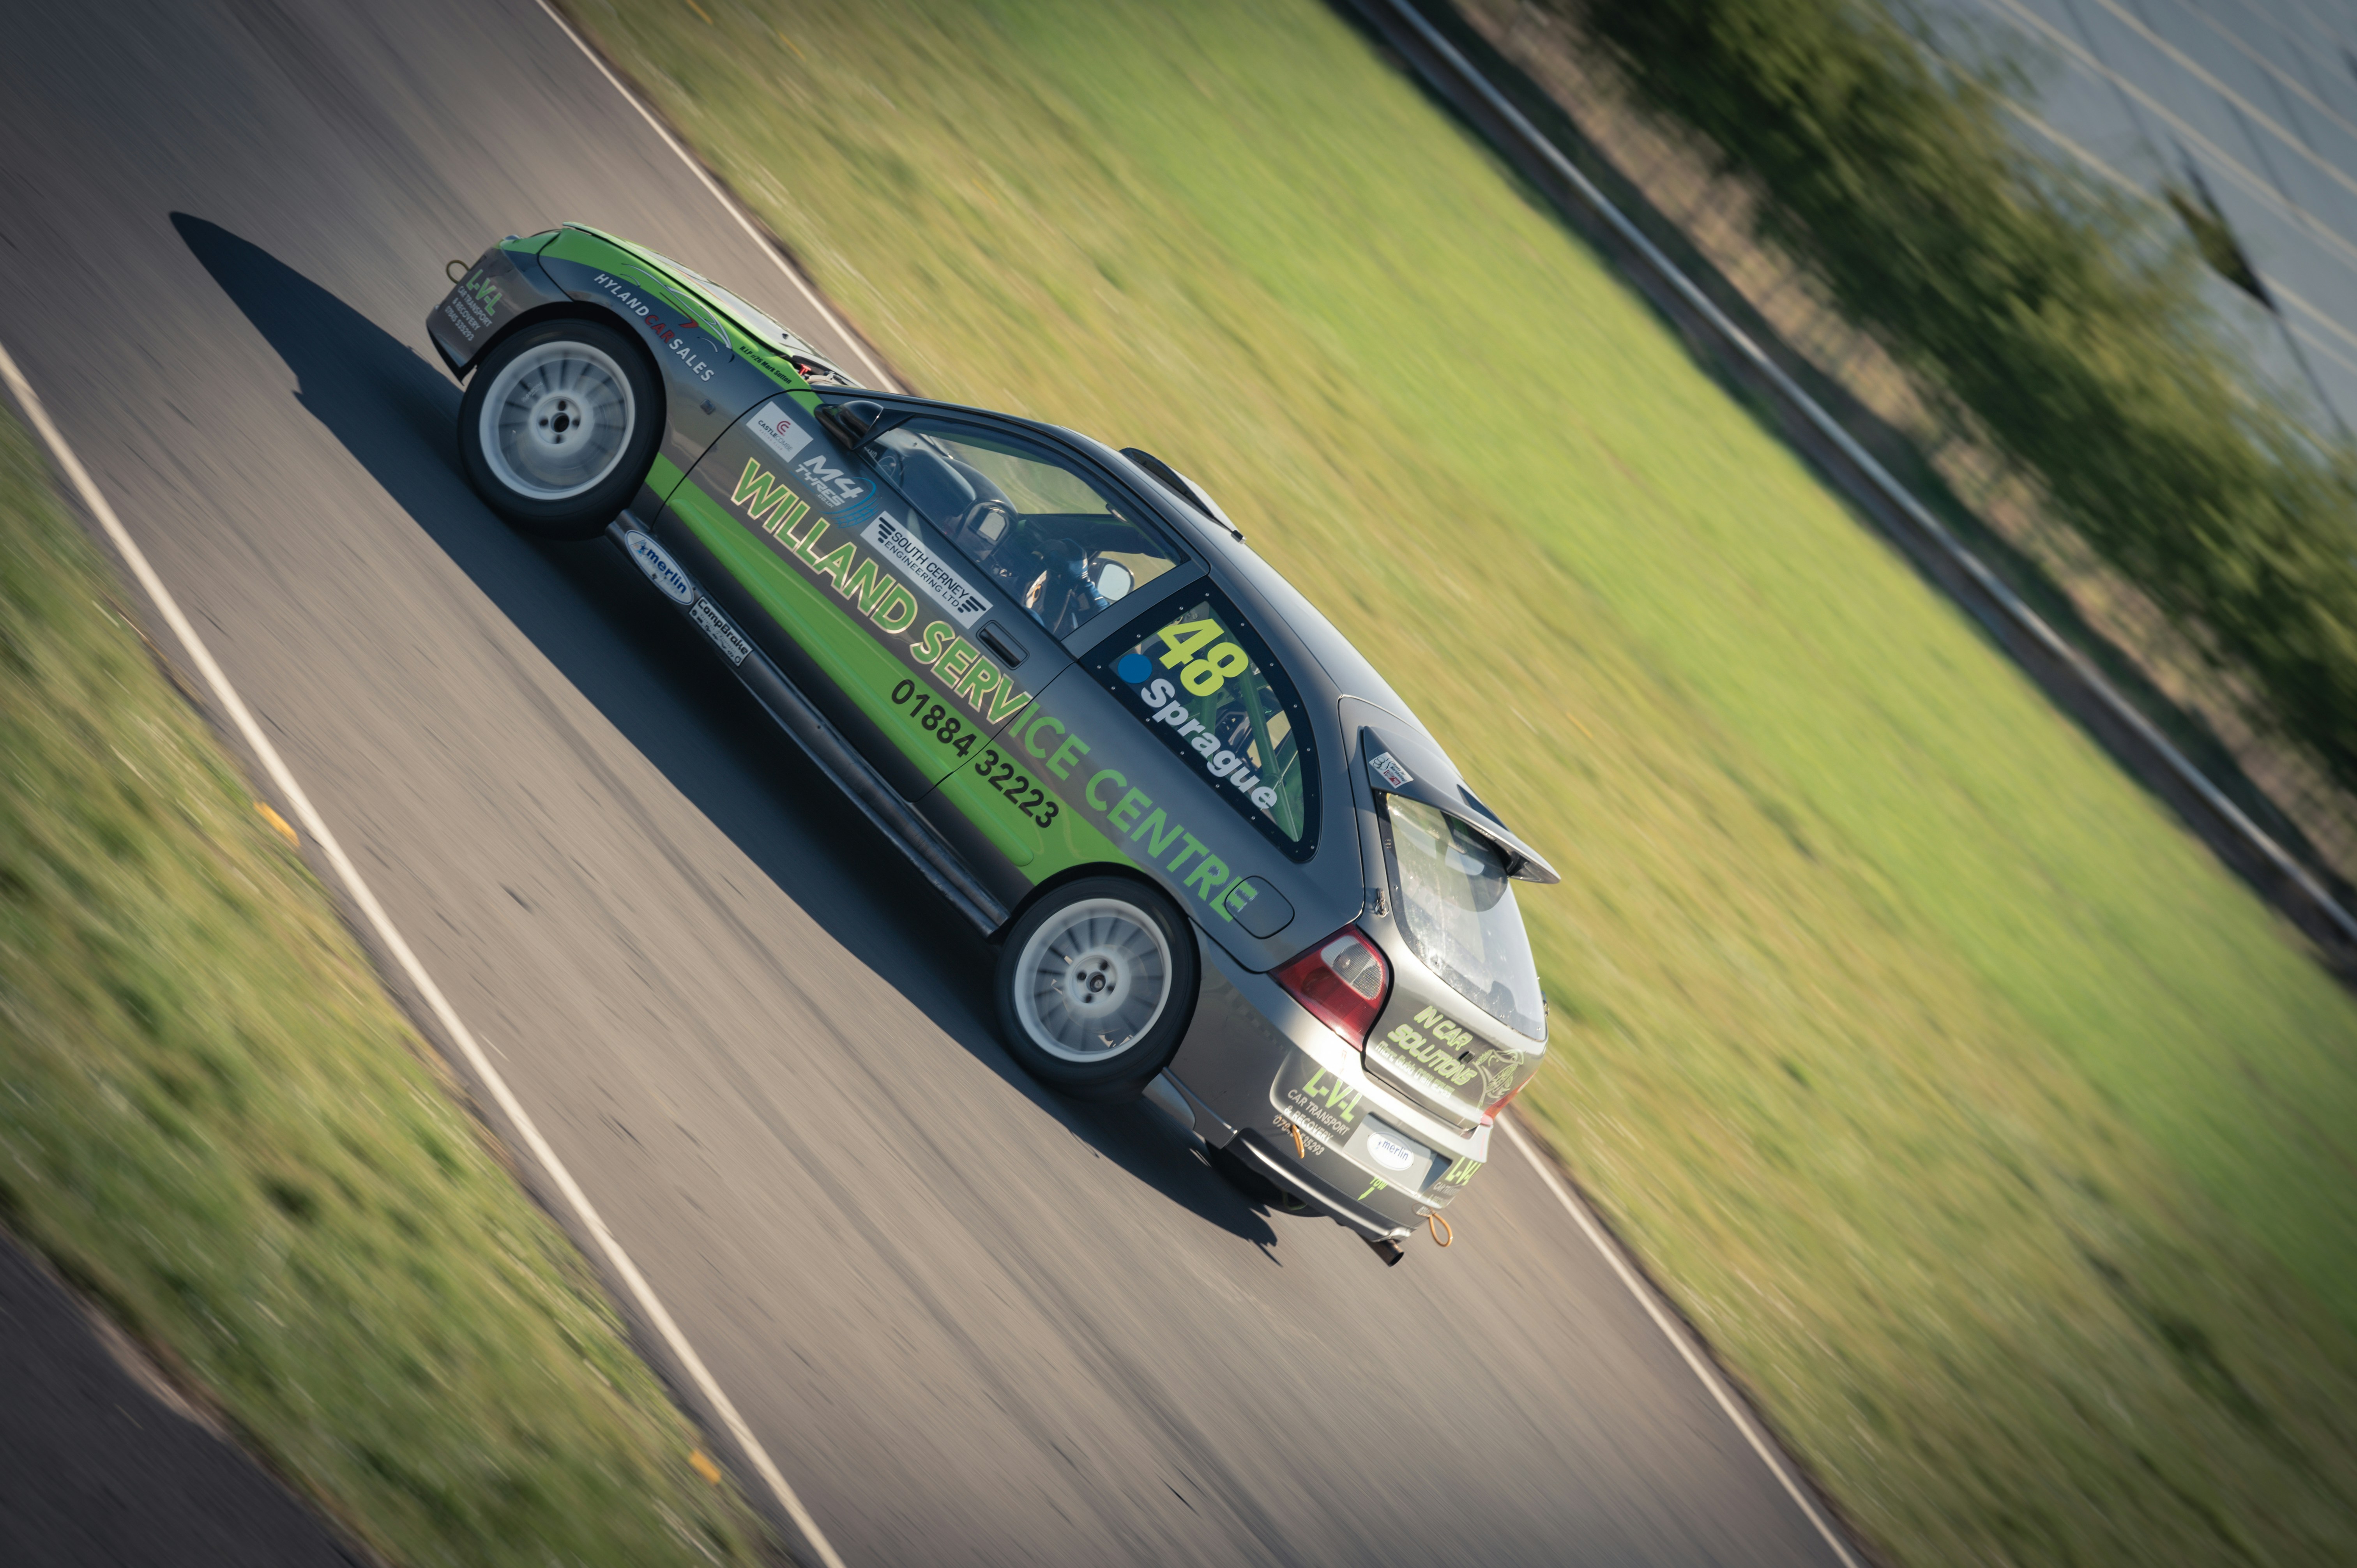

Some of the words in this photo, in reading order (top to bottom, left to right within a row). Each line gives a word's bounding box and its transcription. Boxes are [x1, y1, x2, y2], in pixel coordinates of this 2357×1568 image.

[455, 301, 481, 330] RECOVERY
[457, 286, 467, 298] CAR
[464, 294, 493, 327] TRANSPORT
[466, 269, 502, 316] L-V-L
[455, 319, 474, 341] 535293
[751, 354, 763, 363] #26
[761, 361, 776, 372] Mark
[774, 370, 792, 384] Sutton
[795, 464, 845, 506] TYRES
[803, 455, 864, 499] M4
[647, 549, 686, 593] merlin
[884, 541, 943, 592] ENGINEERING
[942, 591, 959, 607] LTD
[891, 532, 928, 565] SOUTH
[926, 562, 969, 599] CERNEY
[698, 599, 749, 655] CompBrake
[1157, 618, 1249, 697] 48
[730, 457, 917, 634] WILLAND
[910, 620, 1090, 780] SERVICE
[1086, 769, 1258, 922] CENTRE
[891, 679, 977, 758] 01884
[974, 749, 1059, 828] 32223
[1141, 678, 1277, 810] Sprague
[1375, 1040, 1398, 1062] Marc
[1413, 1005, 1444, 1029] IN
[1433, 1020, 1473, 1051] CAR
[1387, 1024, 1478, 1086] SOLUTIONS
[1288, 1089, 1308, 1107] CAR
[1306, 1101, 1350, 1136] TRANSPORT
[1302, 1066, 1363, 1123] L-V-L
[1284, 1105, 1293, 1116] &
[1292, 1110, 1334, 1143] RECOVERY
[1382, 1141, 1409, 1161] merlin
[1369, 1176, 1388, 1191] TOW
